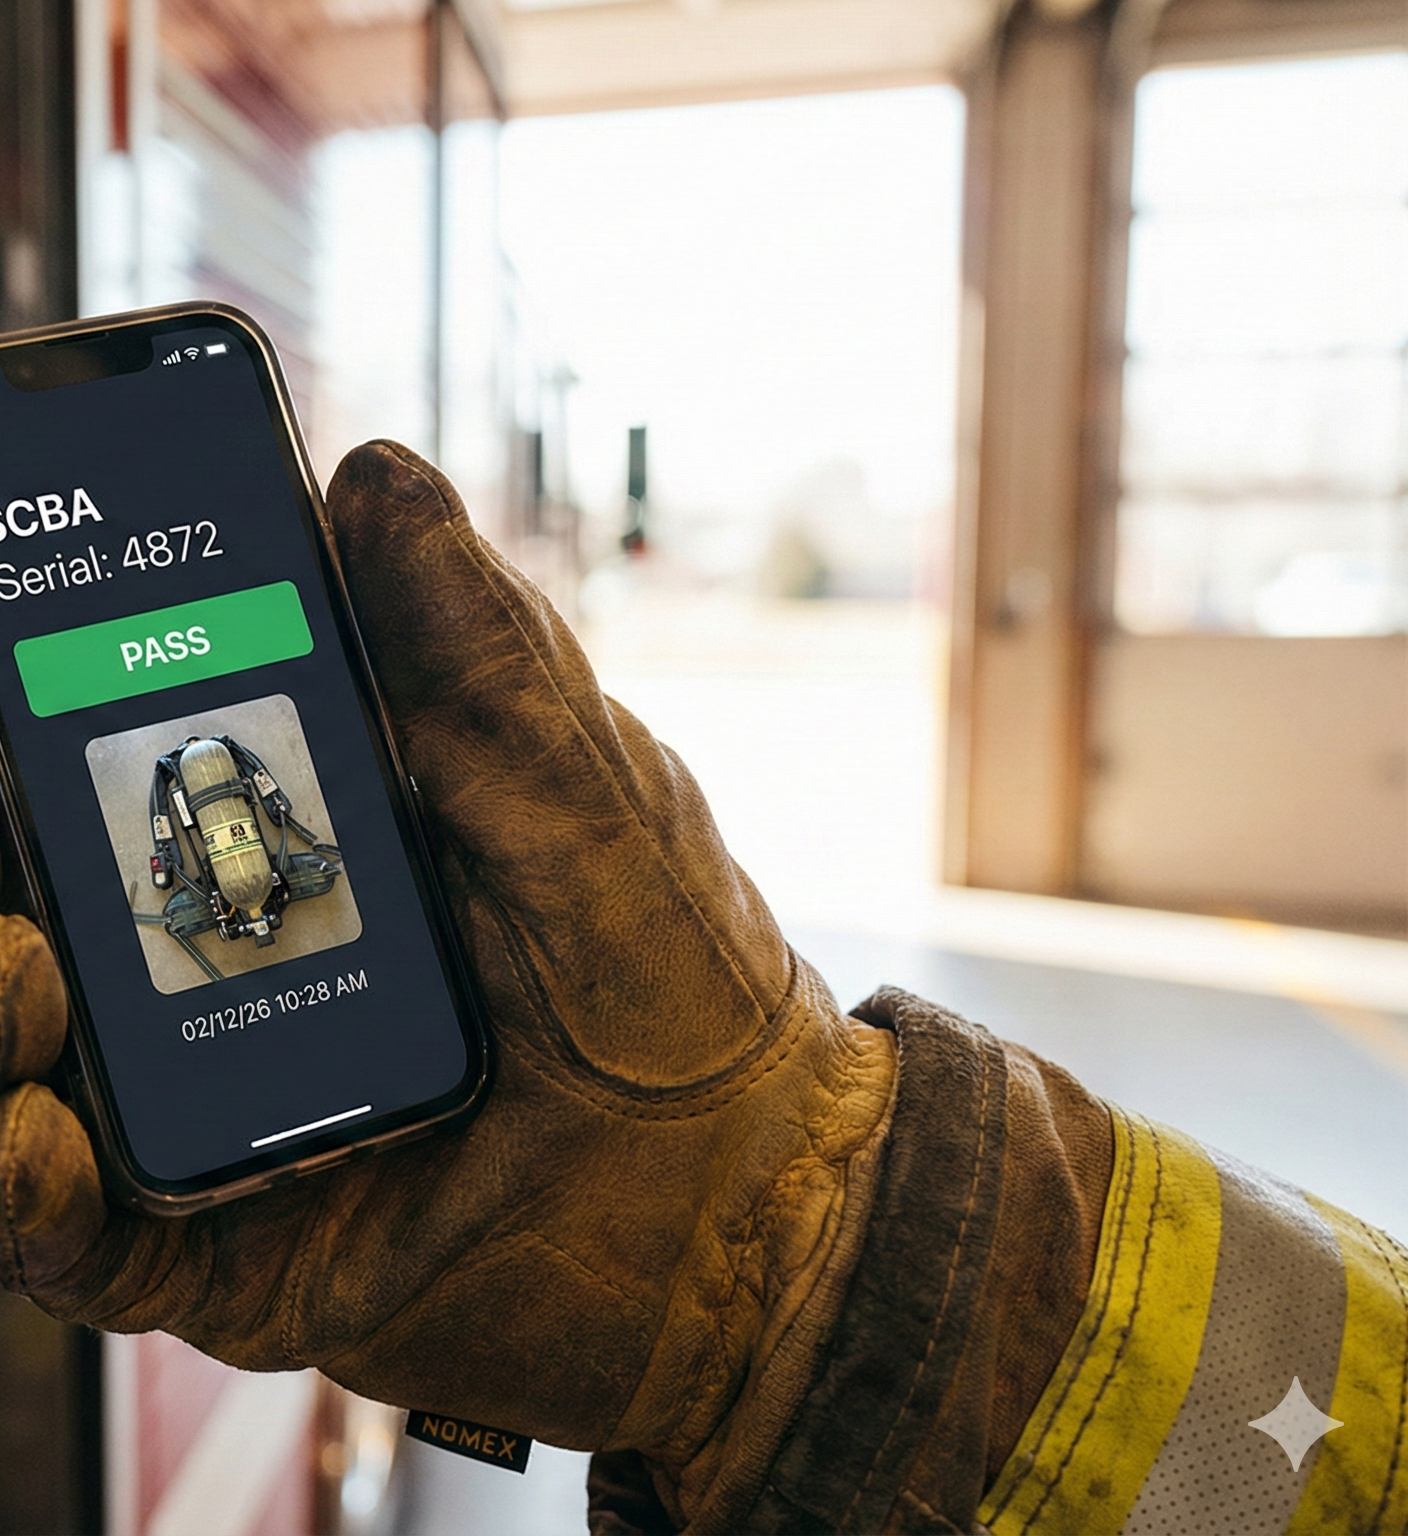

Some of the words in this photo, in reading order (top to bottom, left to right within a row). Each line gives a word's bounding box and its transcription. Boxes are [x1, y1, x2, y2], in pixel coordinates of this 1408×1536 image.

[122, 520, 224, 571] 4872
[119, 625, 212, 672] PASS
[181, 998, 271, 1042] 02/12/26
[274, 981, 331, 1016] 10:28
[336, 969, 369, 997] AM
[421, 1415, 517, 1461] NOMEX
